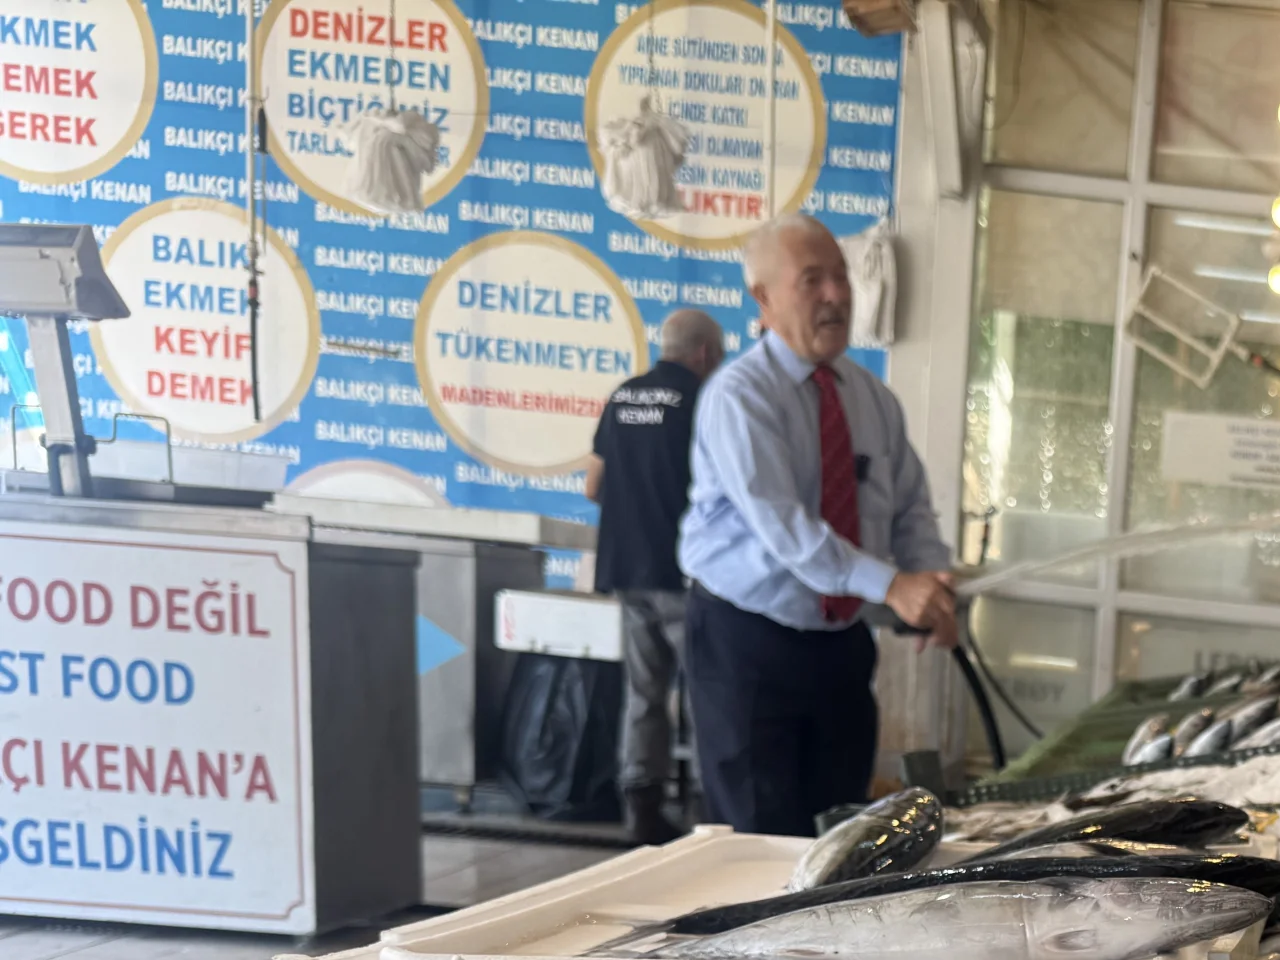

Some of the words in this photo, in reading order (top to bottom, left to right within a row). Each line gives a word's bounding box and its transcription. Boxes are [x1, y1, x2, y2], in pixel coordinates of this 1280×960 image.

[0, 15, 97, 52] KMEK
[289, 7, 449, 53] DENİZLER
[535, 26, 599, 52] KENAN
[162, 35, 233, 64] BALIKÇI
[3, 63, 98, 100] EMEK
[287, 49, 450, 92] EKMEDEN
[485, 67, 531, 95] LIKÇI
[534, 73, 590, 98] KENA
[834, 56, 898, 80] KENAN
[163, 81, 233, 110] BALIKÇI
[0, 110, 97, 147] EREK
[831, 101, 895, 126] KENAN
[164, 126, 234, 156] BALIKÇI
[534, 118, 588, 143] KENA
[466, 157, 530, 186] ALIKÇI
[533, 162, 596, 189] KENAN
[828, 147, 891, 172] KENAN
[91, 179, 151, 205] KENAN
[165, 171, 234, 201] BALIKÇI
[458, 200, 529, 230] BALIKÇI
[532, 207, 594, 234] KENAN
[152, 234, 249, 270] BALIK
[314, 245, 384, 275] BALIKÇI
[315, 289, 384, 320] BALIKÇI
[458, 276, 613, 323] DENİZLER
[683, 282, 743, 308] KENAN
[154, 326, 252, 360] KEYİF
[435, 326, 632, 375] TÜKENMEYEN
[314, 376, 384, 407] BALIKÇI
[387, 383, 428, 407] KEN
[440, 384, 607, 418] MADENLERİMİZD
[314, 419, 384, 450] BALIKÇI
[387, 427, 447, 452] KENAN
[0, 577, 114, 627] OOD
[129, 580, 271, 638] DEĞİL
[61, 654, 195, 705] FOOD
[0, 738, 43, 793] ÇI
[61, 741, 278, 802] KENAN'A
